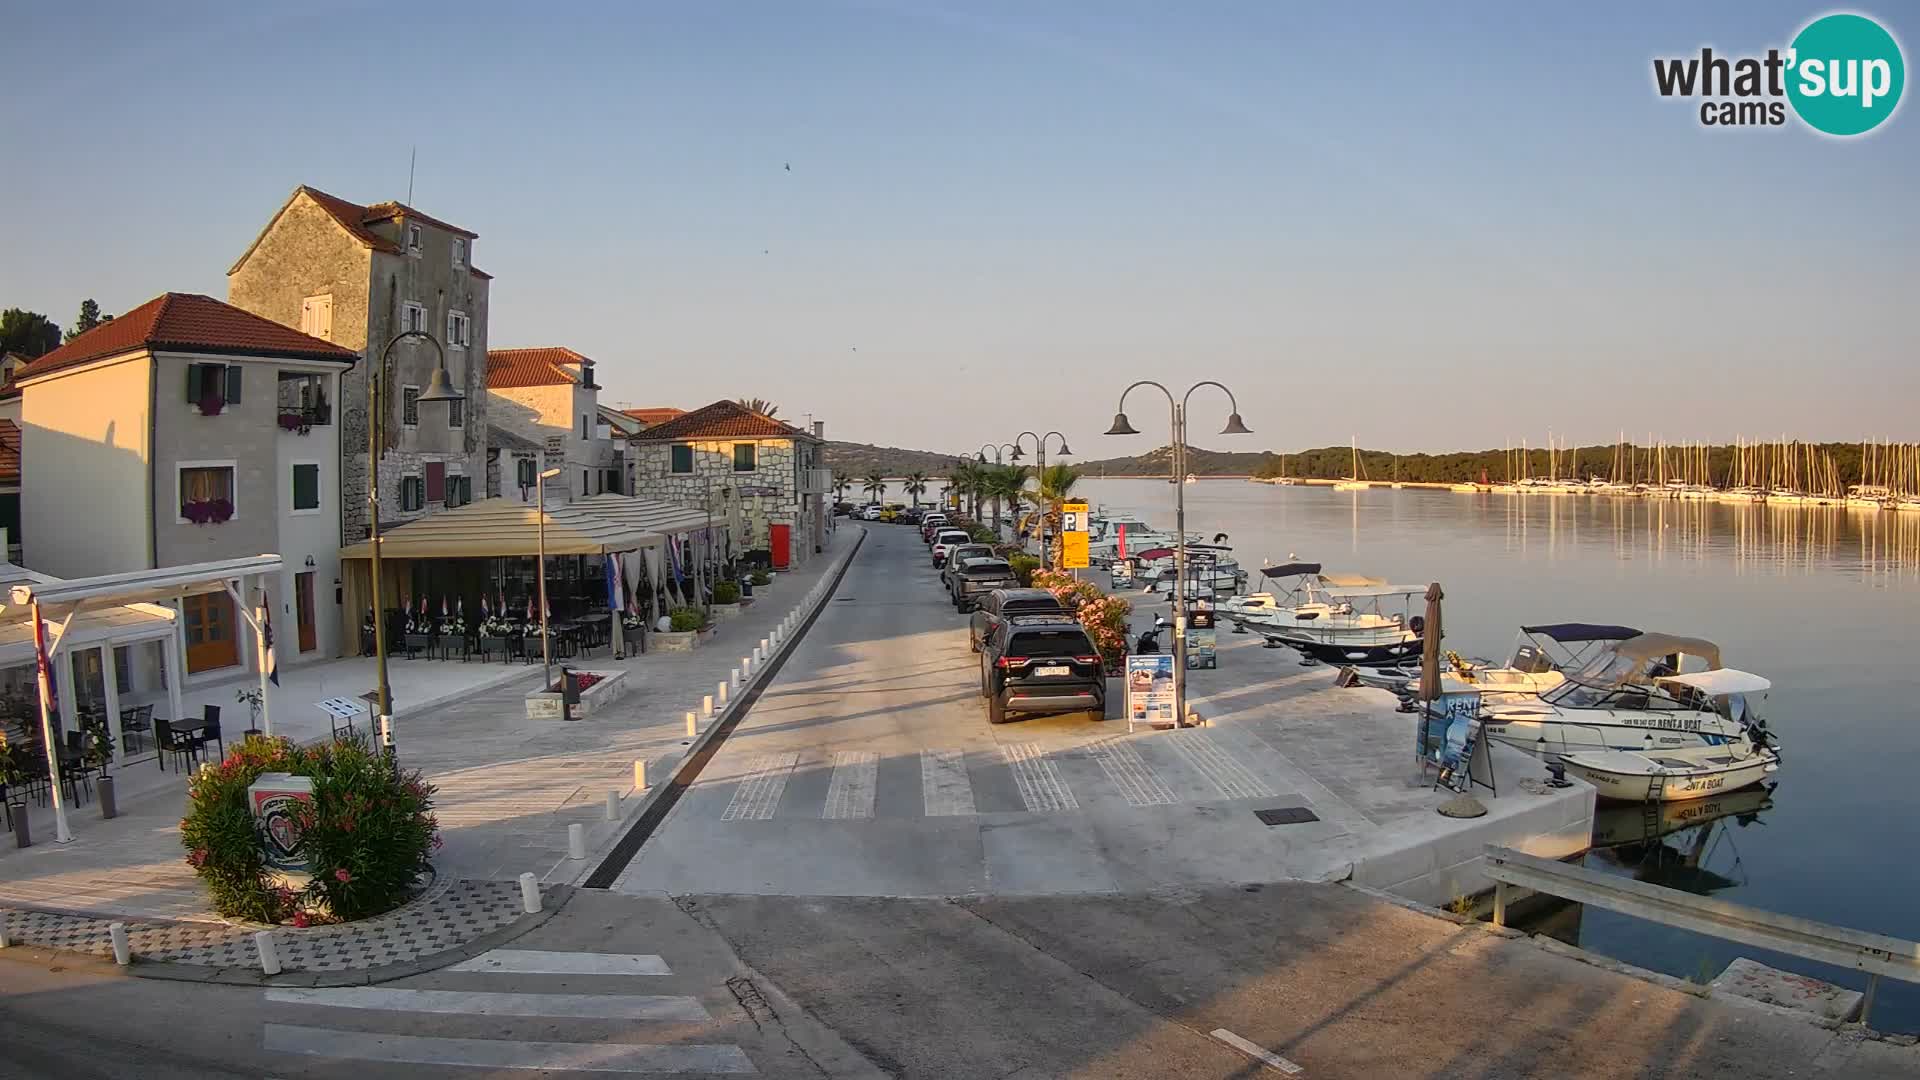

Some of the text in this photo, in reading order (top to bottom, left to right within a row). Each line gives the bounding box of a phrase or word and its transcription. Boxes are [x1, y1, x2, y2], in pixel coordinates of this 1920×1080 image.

[1065, 513, 1076, 530] P
[1447, 698, 1478, 710] RENT
[1657, 718, 1677, 729] RENT
[1677, 719, 1683, 729] A
[1706, 777, 1724, 789] BOAT
